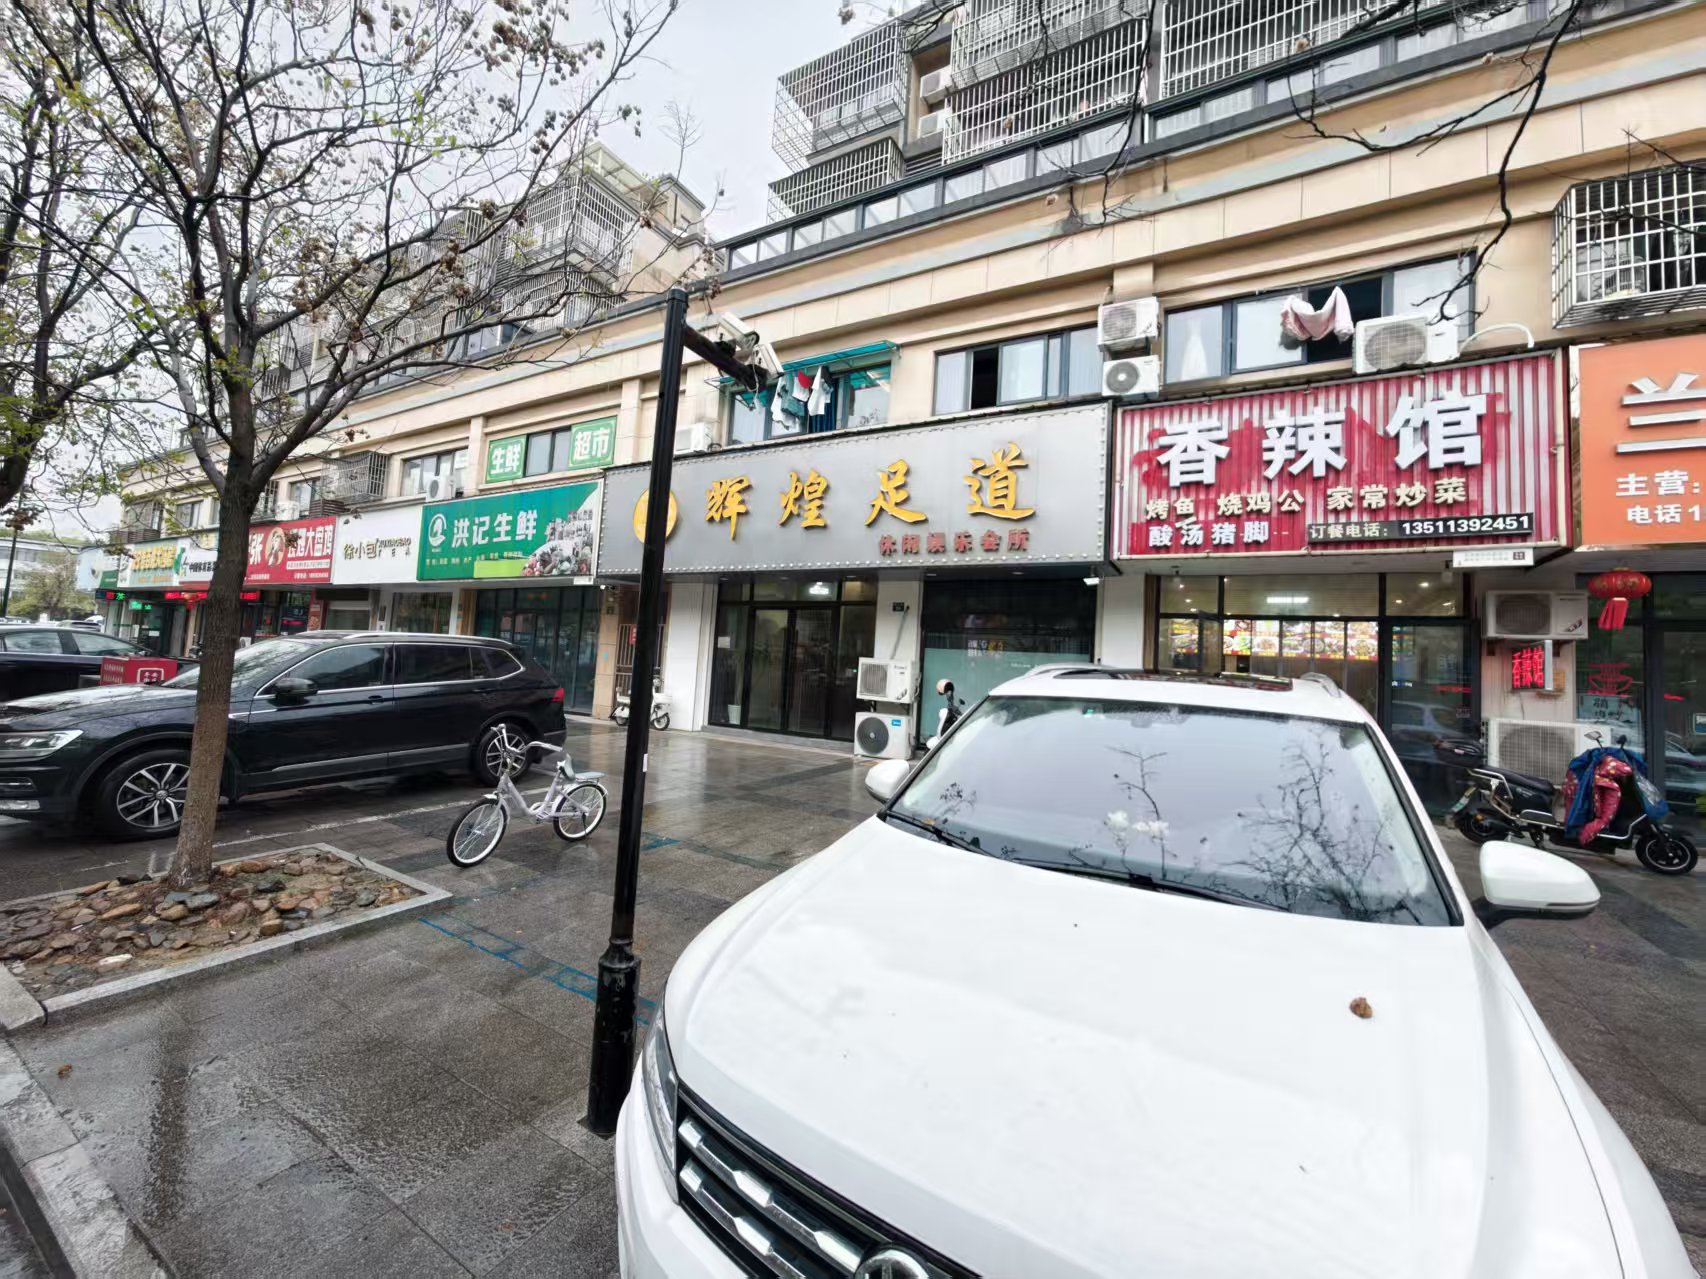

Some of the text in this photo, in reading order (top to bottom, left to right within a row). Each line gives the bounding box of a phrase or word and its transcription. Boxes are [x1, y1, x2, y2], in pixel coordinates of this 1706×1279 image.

[1615, 372, 1706, 453] 兰
[574, 427, 610, 460] 超市
[1156, 390, 1487, 487] 香辣馆
[490, 444, 520, 474] 生鲜
[705, 441, 1035, 540] 辉煌足道
[1146, 477, 1467, 528] 烤鱼 烧鸡公 家常炒菜
[451, 509, 538, 548] 洪记生鲜
[1149, 520, 1269, 547] 酸汤猪脚
[1402, 515, 1529, 534] 13511392451
[344, 539, 378, 560] 徐小包
[879, 528, 1030, 556] 休闲娱乐会所
